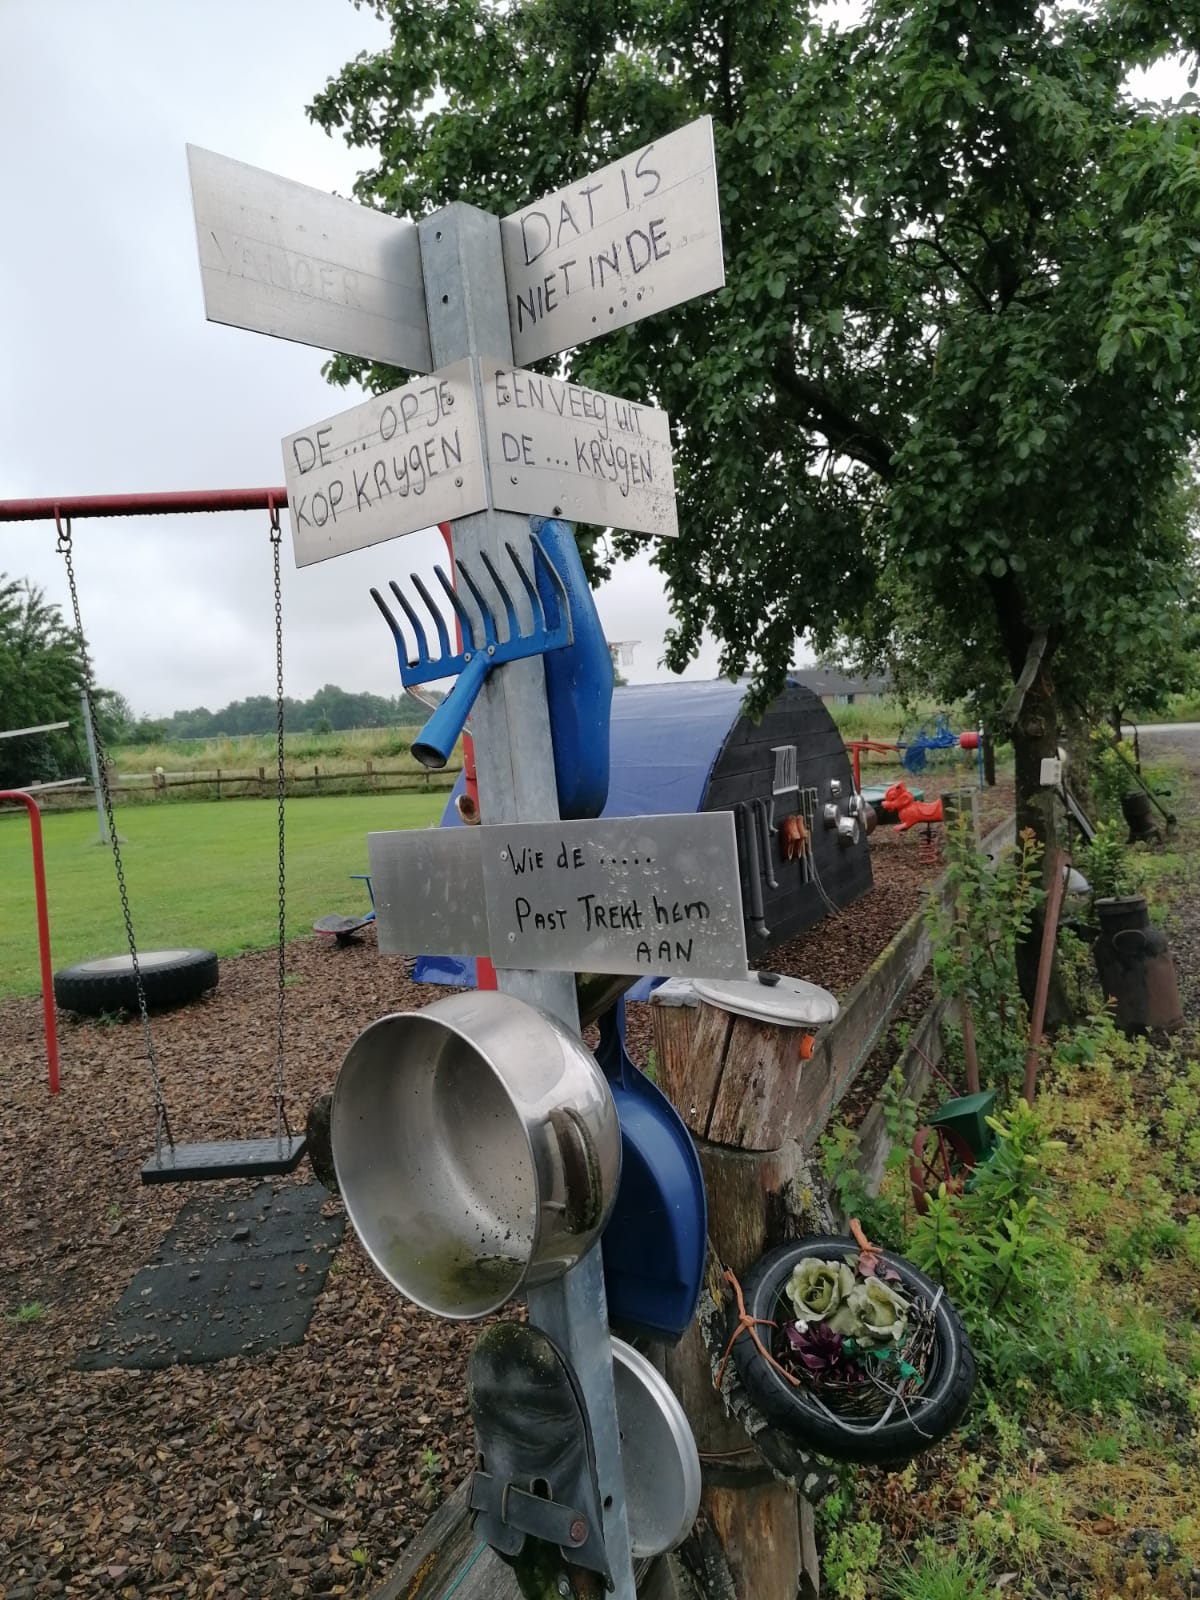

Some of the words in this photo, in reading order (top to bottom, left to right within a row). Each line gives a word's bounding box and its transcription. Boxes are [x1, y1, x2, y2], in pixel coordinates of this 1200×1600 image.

[520, 183, 603, 266] DAT
[621, 144, 661, 209] IS
[516, 260, 577, 333] NIET
[292, 480, 344, 534] KOP
[515, 897, 567, 933] PAST
[636, 938, 693, 964] AAN
